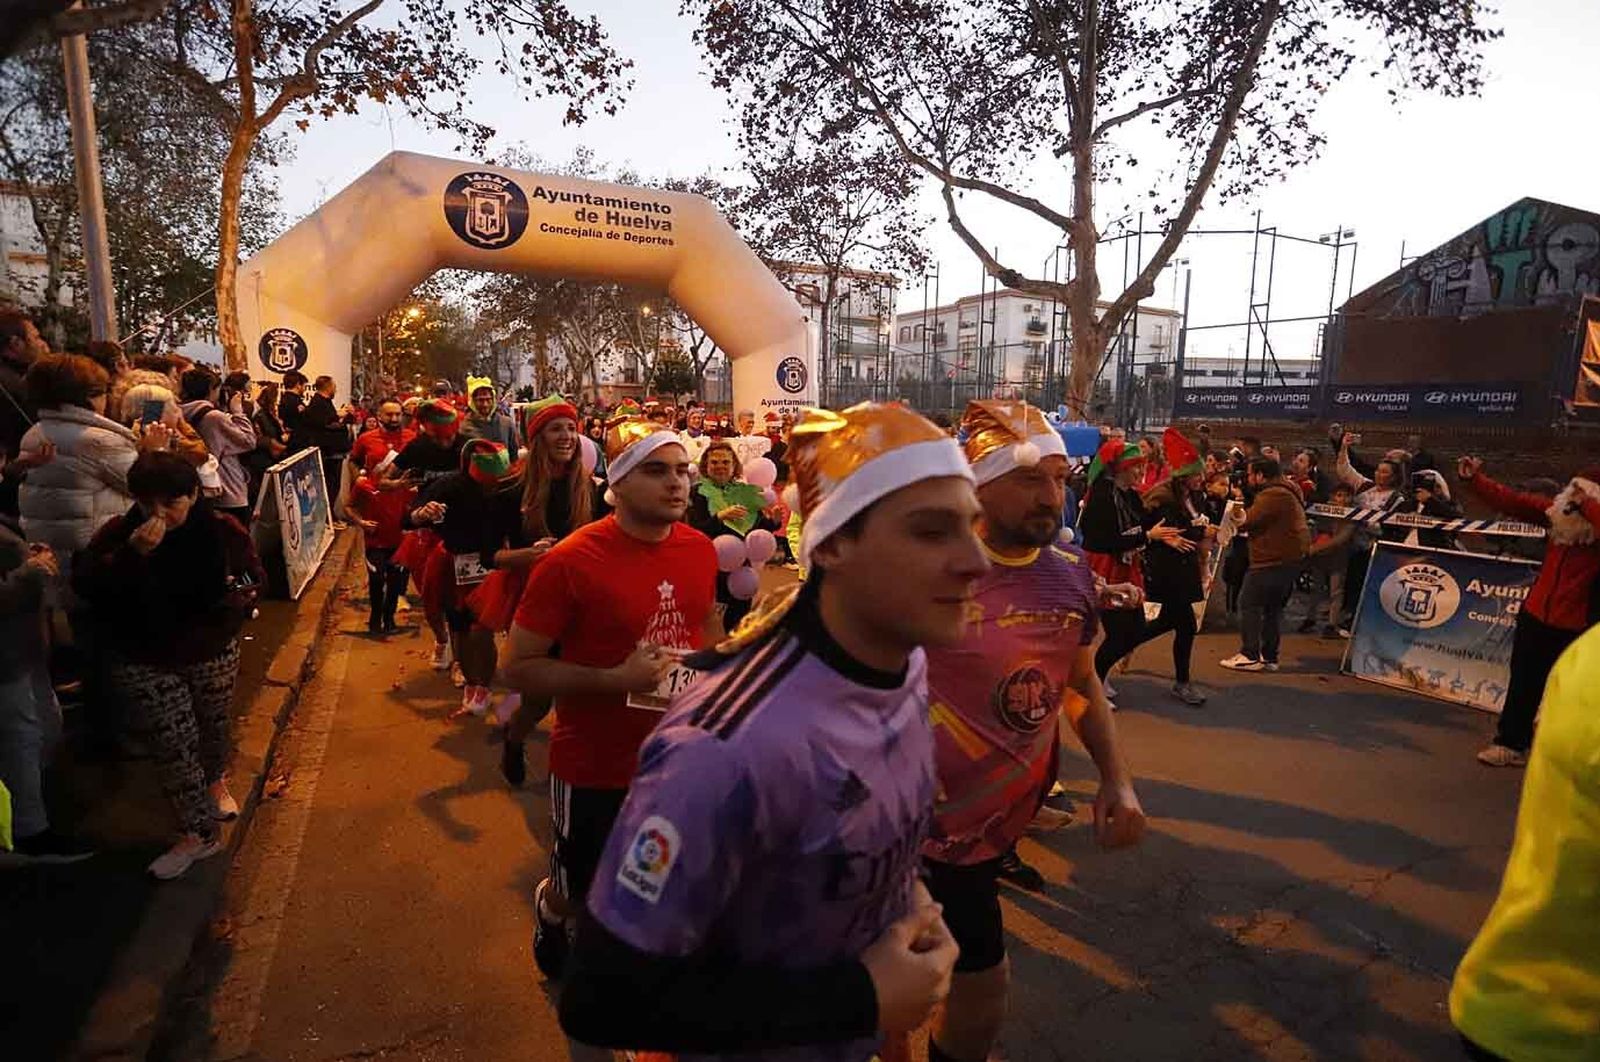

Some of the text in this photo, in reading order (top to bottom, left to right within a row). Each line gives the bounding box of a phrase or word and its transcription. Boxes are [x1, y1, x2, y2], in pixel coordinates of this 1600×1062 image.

[532, 185, 672, 215] Ayuntamiento
[575, 206, 672, 232] de Huelva
[606, 229, 620, 241] de
[624, 231, 674, 247] Deportes
[1200, 394, 1238, 403] HYUNDAI
[1265, 394, 1310, 403] HYUNDAI
[1355, 393, 1409, 402] HYUNDAI
[1451, 391, 1517, 403] HYUNDAI
[1466, 579, 1530, 600] Ayunt
[1506, 601, 1522, 614] d
